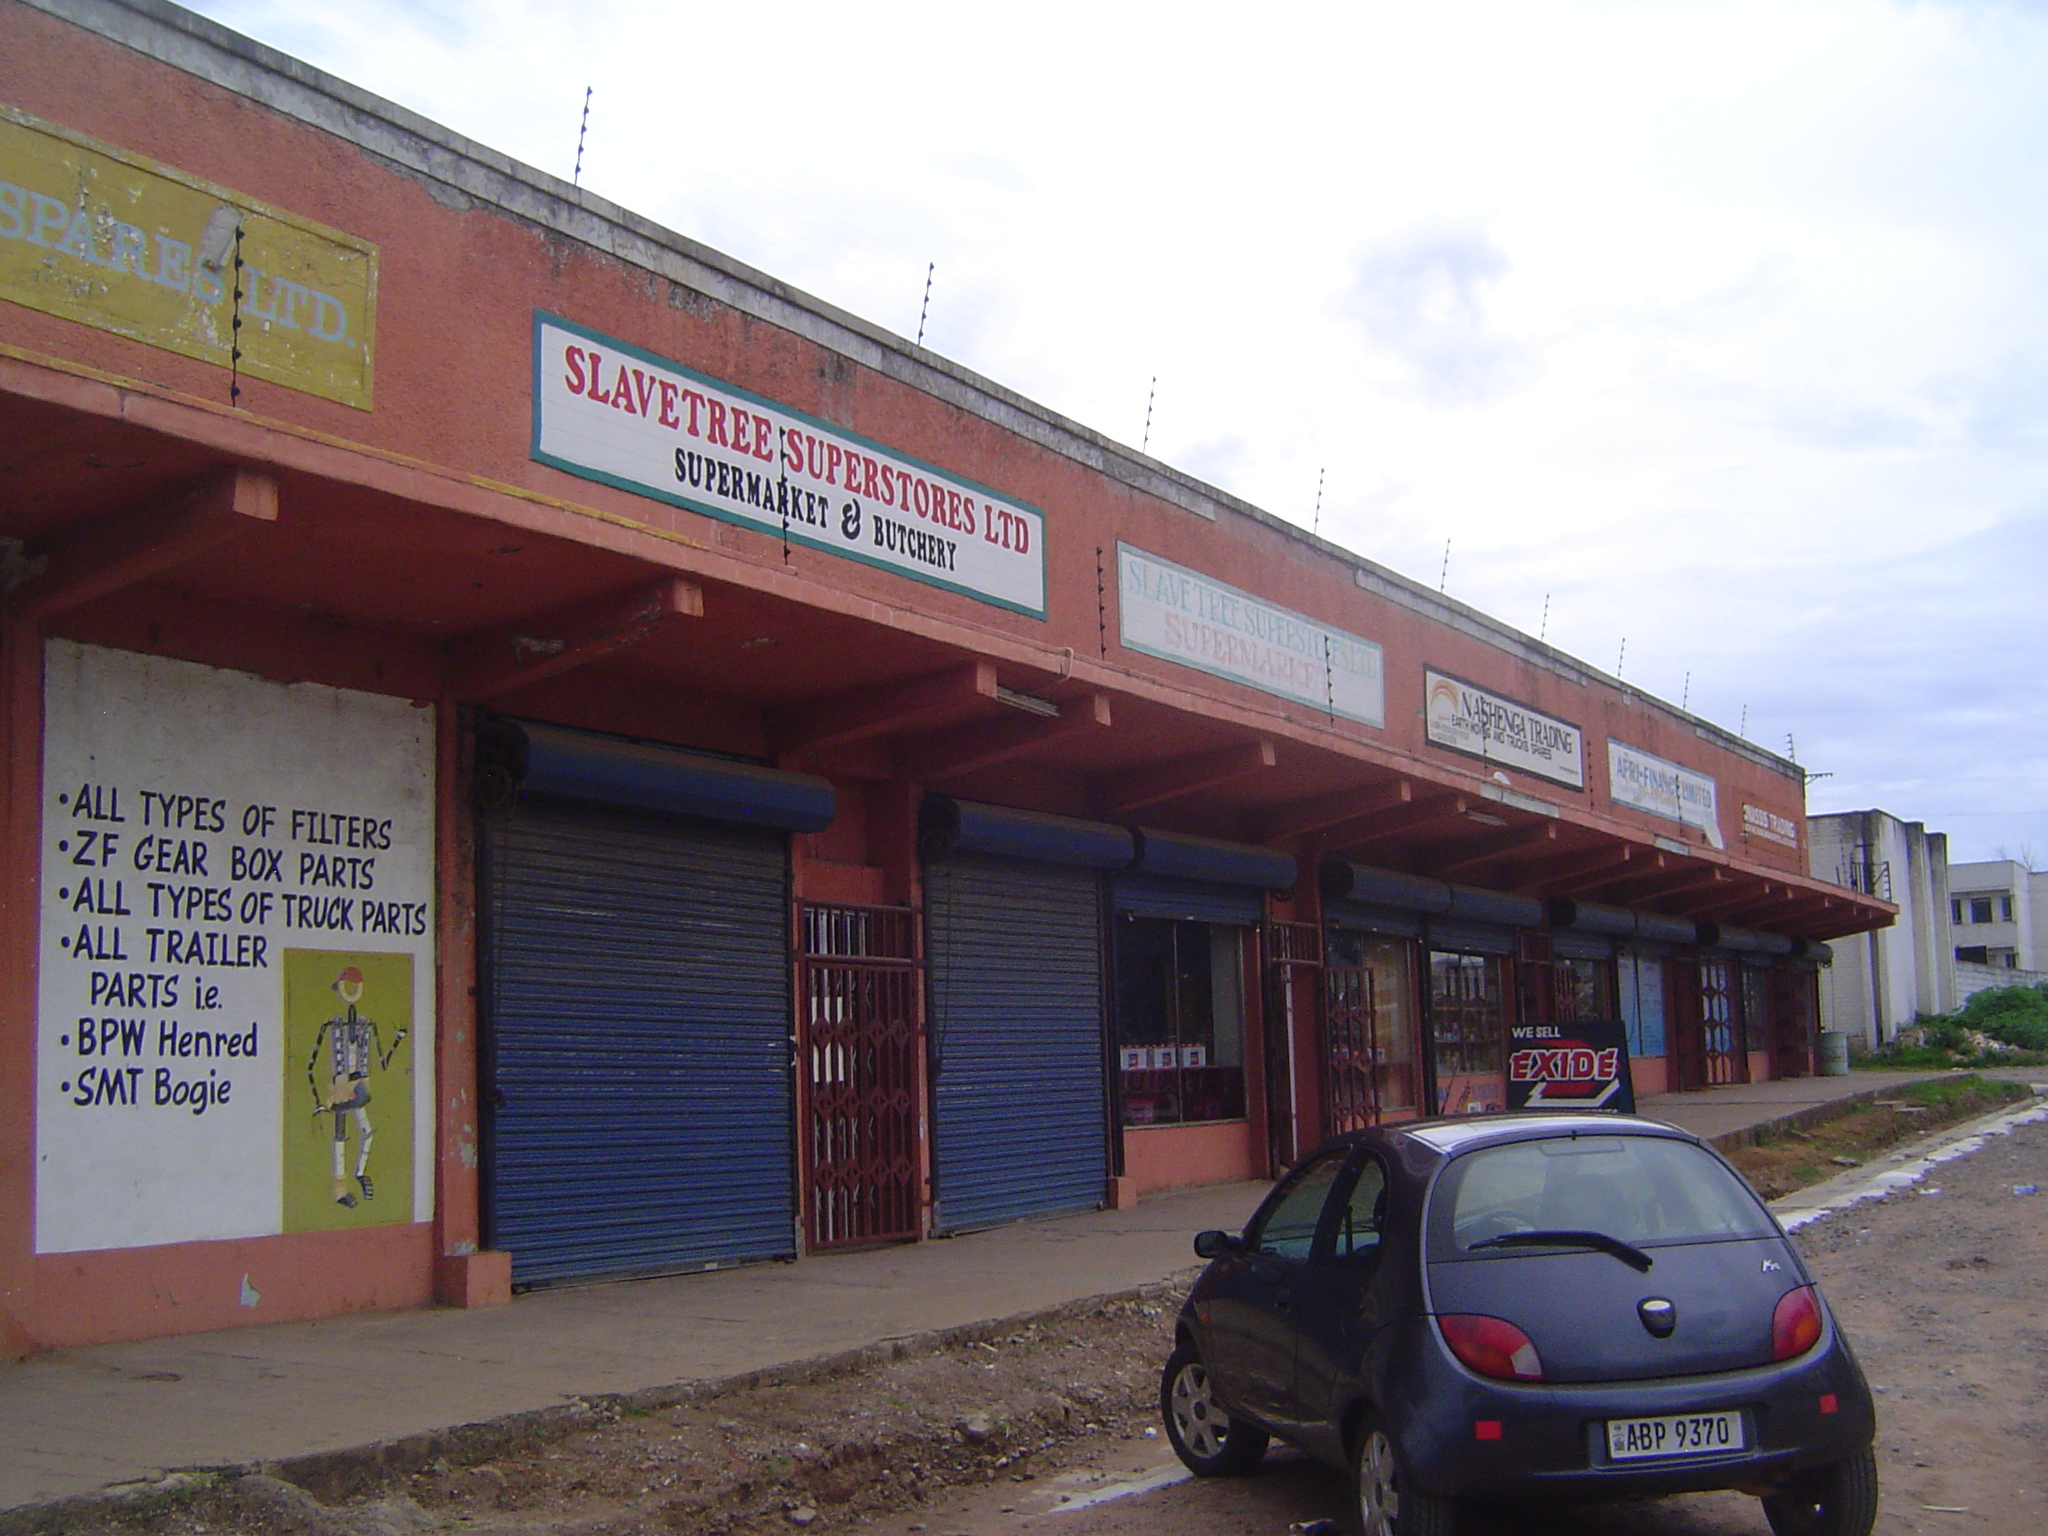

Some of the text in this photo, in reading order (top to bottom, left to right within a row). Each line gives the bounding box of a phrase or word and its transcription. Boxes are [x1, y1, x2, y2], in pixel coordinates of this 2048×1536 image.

[240, 264, 357, 348] LTD.
[564, 344, 1031, 556] SLAVETREE SUPERSTORES LTD
[674, 446, 958, 572] SUPERMARKET & BUTCHERY
[1528, 717, 1573, 754] TRADING
[1616, 756, 1679, 798] AFRI-FINANC
[71, 782, 393, 851] ALL TYPES OF FILTERS
[72, 829, 375, 891] ZF GEAR BOX PARTS
[72, 876, 427, 936] ALL TYPES OF TRUCK PARTS
[72, 923, 268, 969] ALL TRAILER
[90, 970, 179, 1009] PARTS
[77, 1016, 258, 1058] BPW Henred
[1511, 1026, 1561, 1039] WE SELL
[1509, 1047, 1620, 1082] EXIDE
[73, 1065, 231, 1115] SMT Bogie
[1626, 1416, 1730, 1452] ABP 9370
